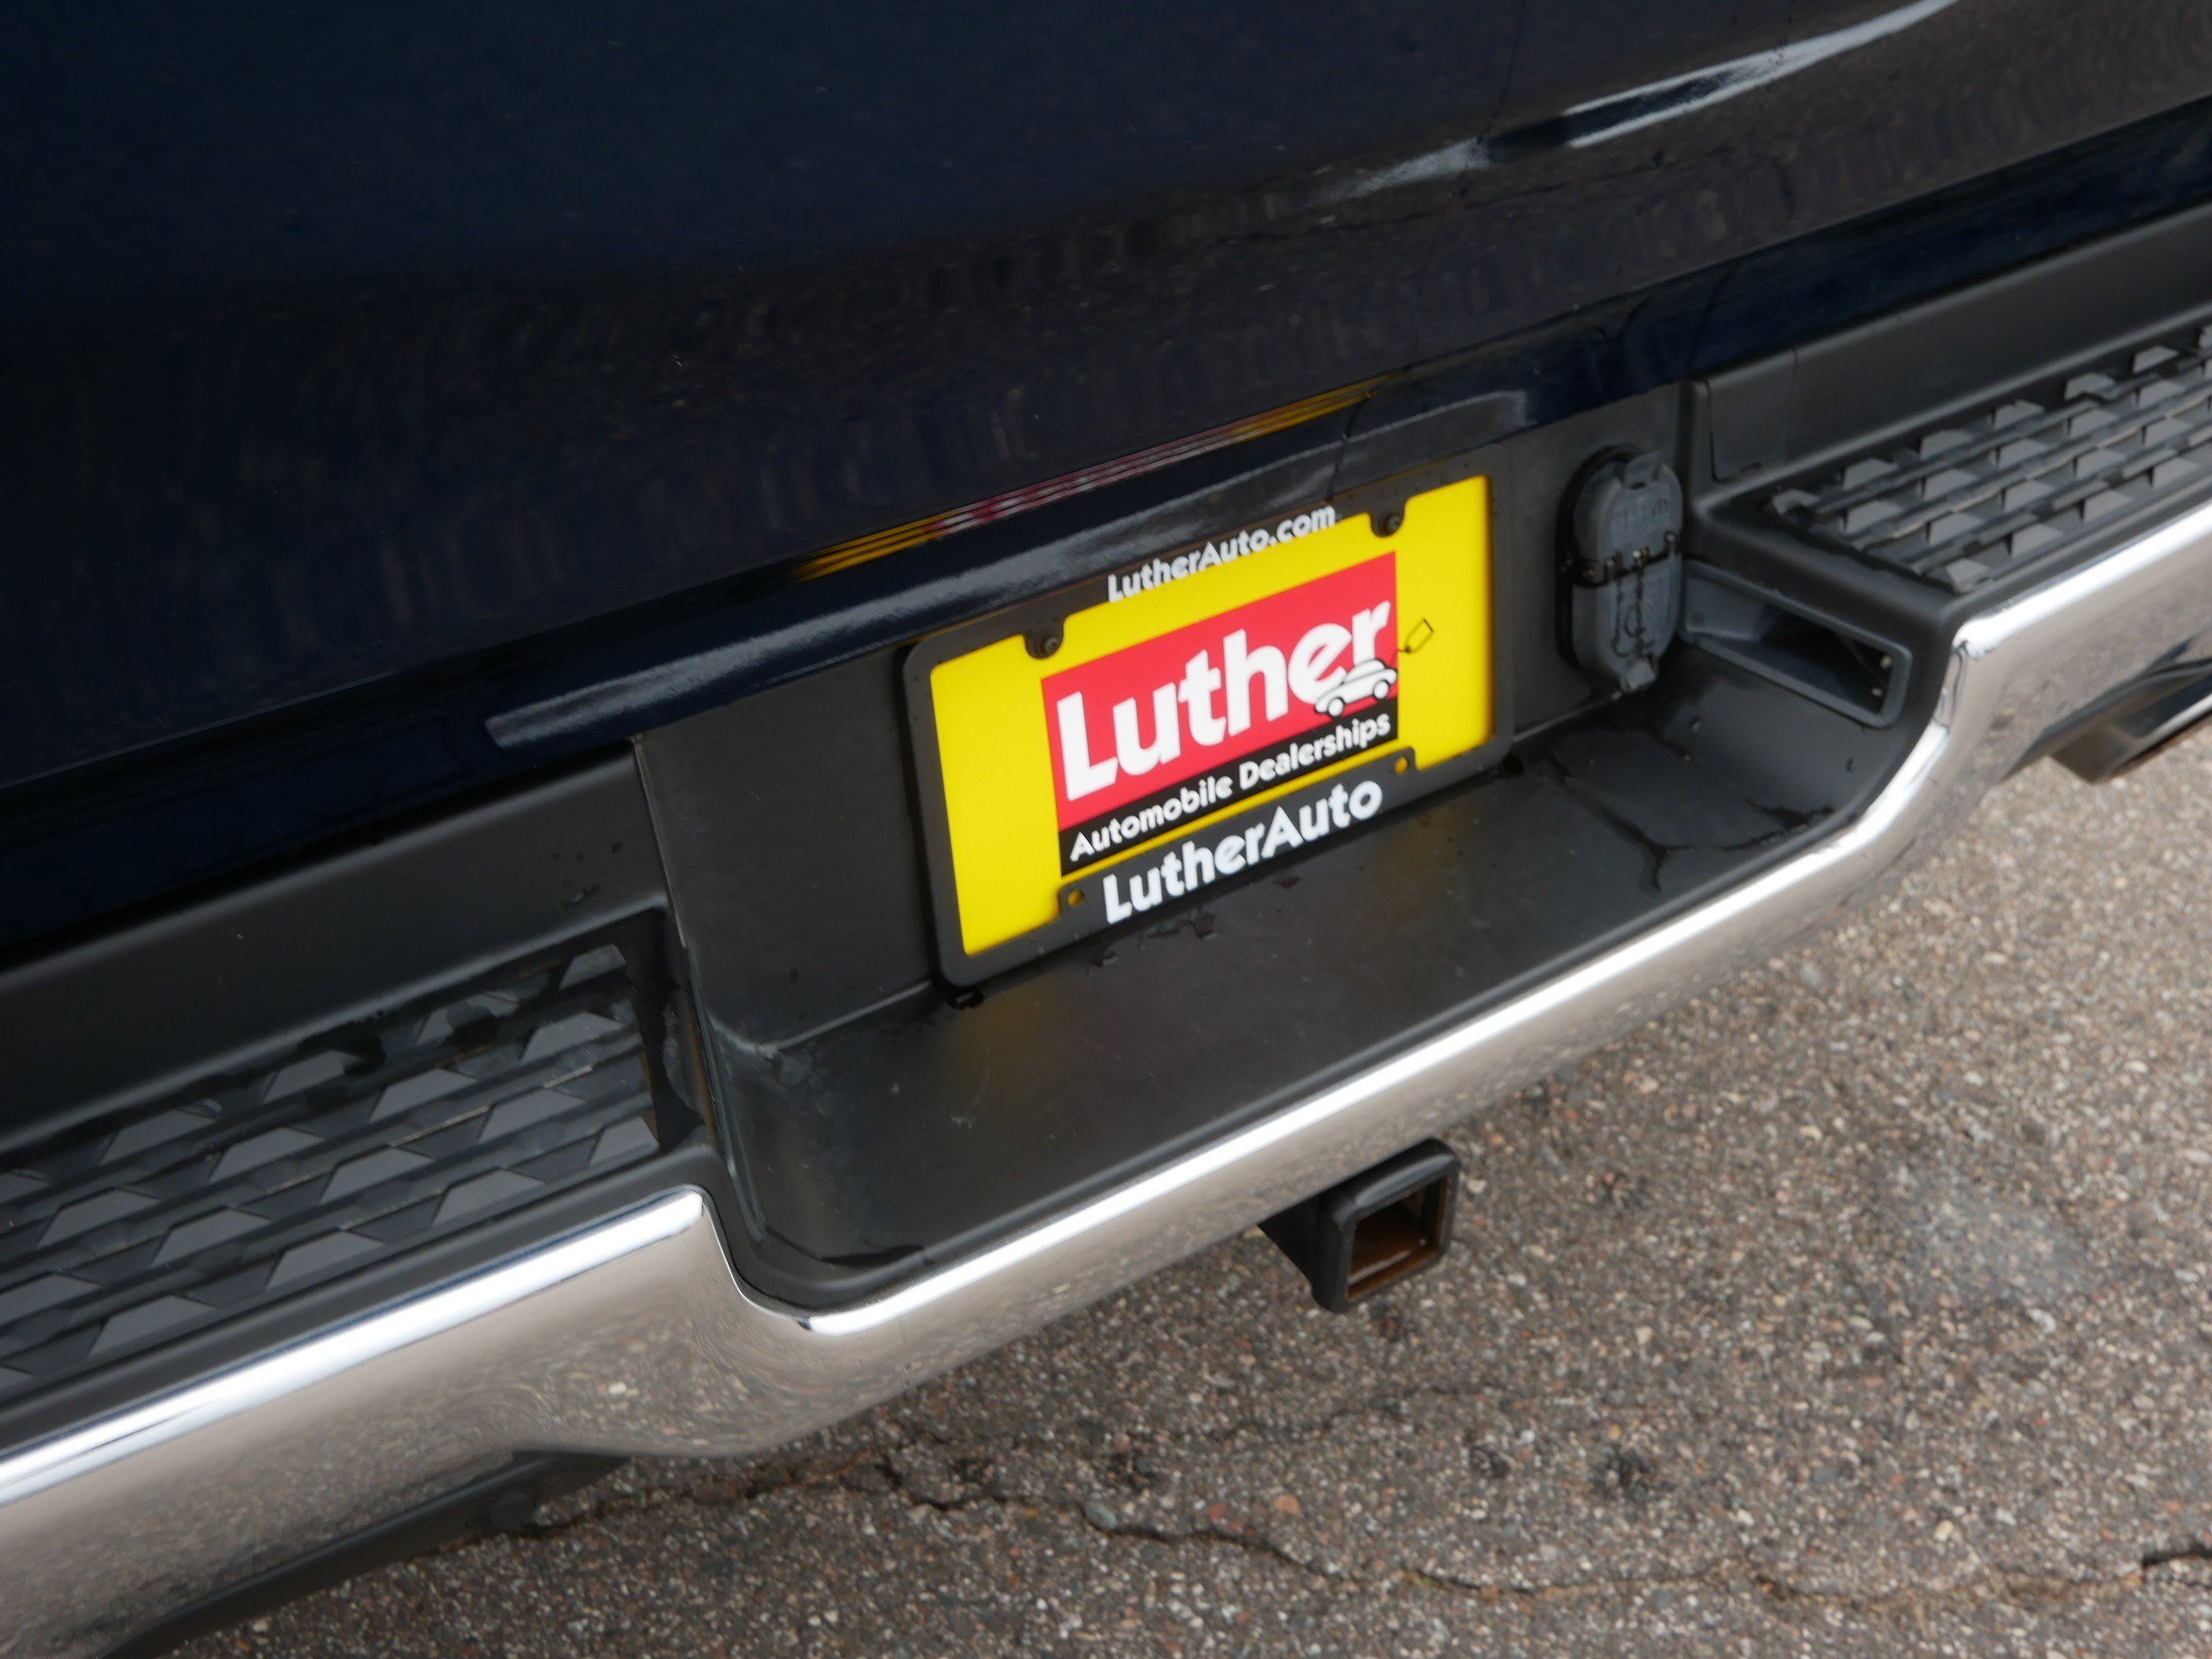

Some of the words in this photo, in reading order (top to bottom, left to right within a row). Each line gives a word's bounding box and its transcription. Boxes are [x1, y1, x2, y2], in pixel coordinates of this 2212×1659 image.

[1107, 504, 1336, 603] LutherAuto.com
[1056, 600, 1391, 801] Luther
[1069, 774, 1234, 863] Automobile
[1238, 712, 1392, 791] Dealerships
[1102, 780, 1383, 924] LutherAuto
